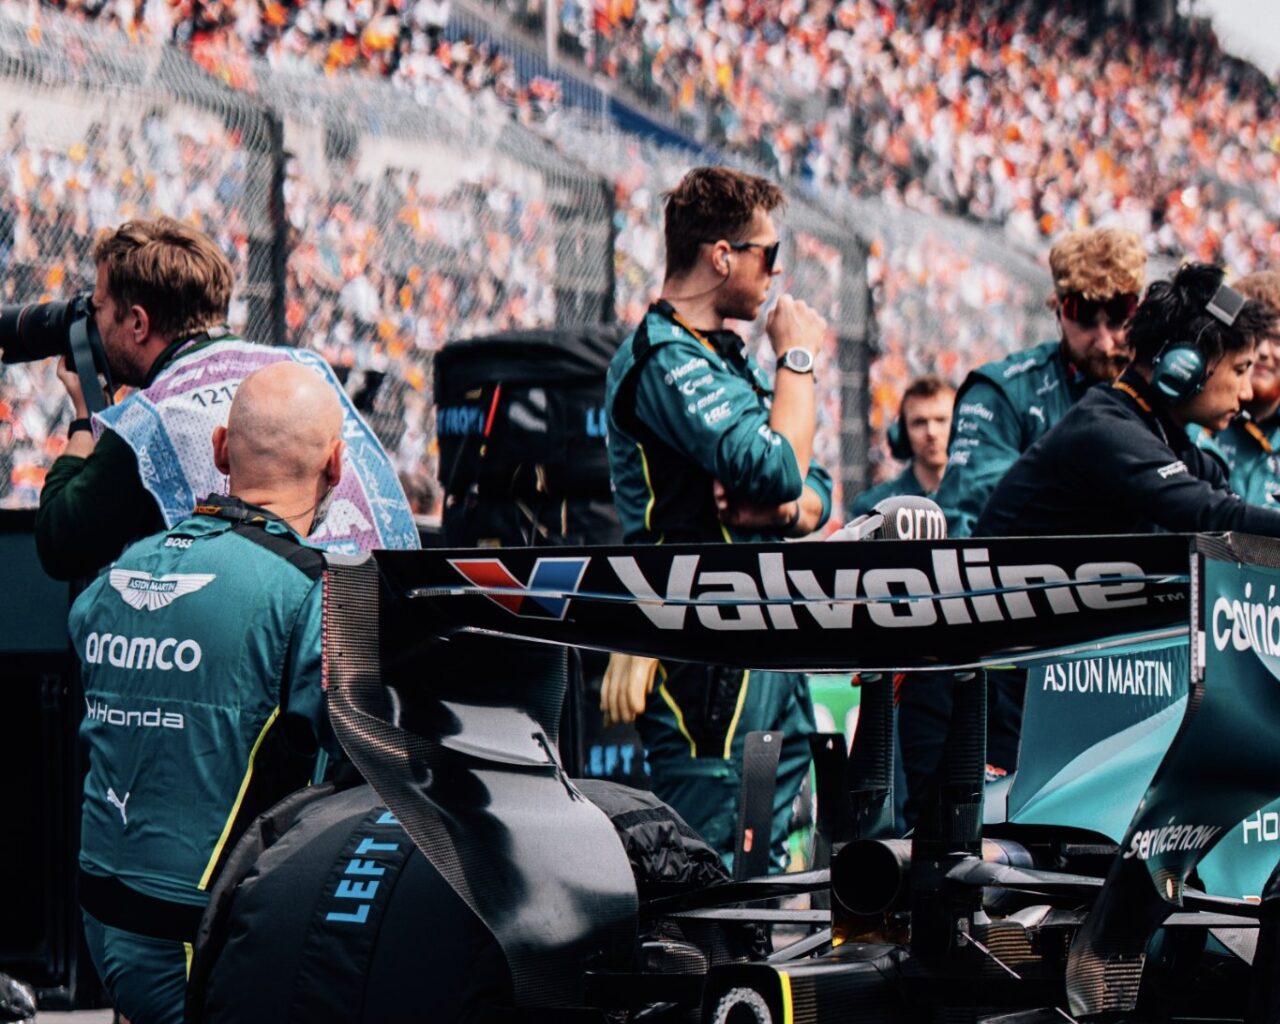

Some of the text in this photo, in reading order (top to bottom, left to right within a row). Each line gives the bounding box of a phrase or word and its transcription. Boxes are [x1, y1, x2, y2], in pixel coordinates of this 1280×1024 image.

[192, 383, 238, 407] 121
[164, 537, 194, 549] BOSS
[896, 507, 945, 540] arm
[607, 549, 1147, 631] Valvoline
[85, 631, 202, 673] aramco
[1043, 658, 1172, 697] ASTON MARTIN
[95, 703, 184, 729] Honda
[1123, 816, 1222, 859] servicenow
[326, 838, 400, 924] LEFT
